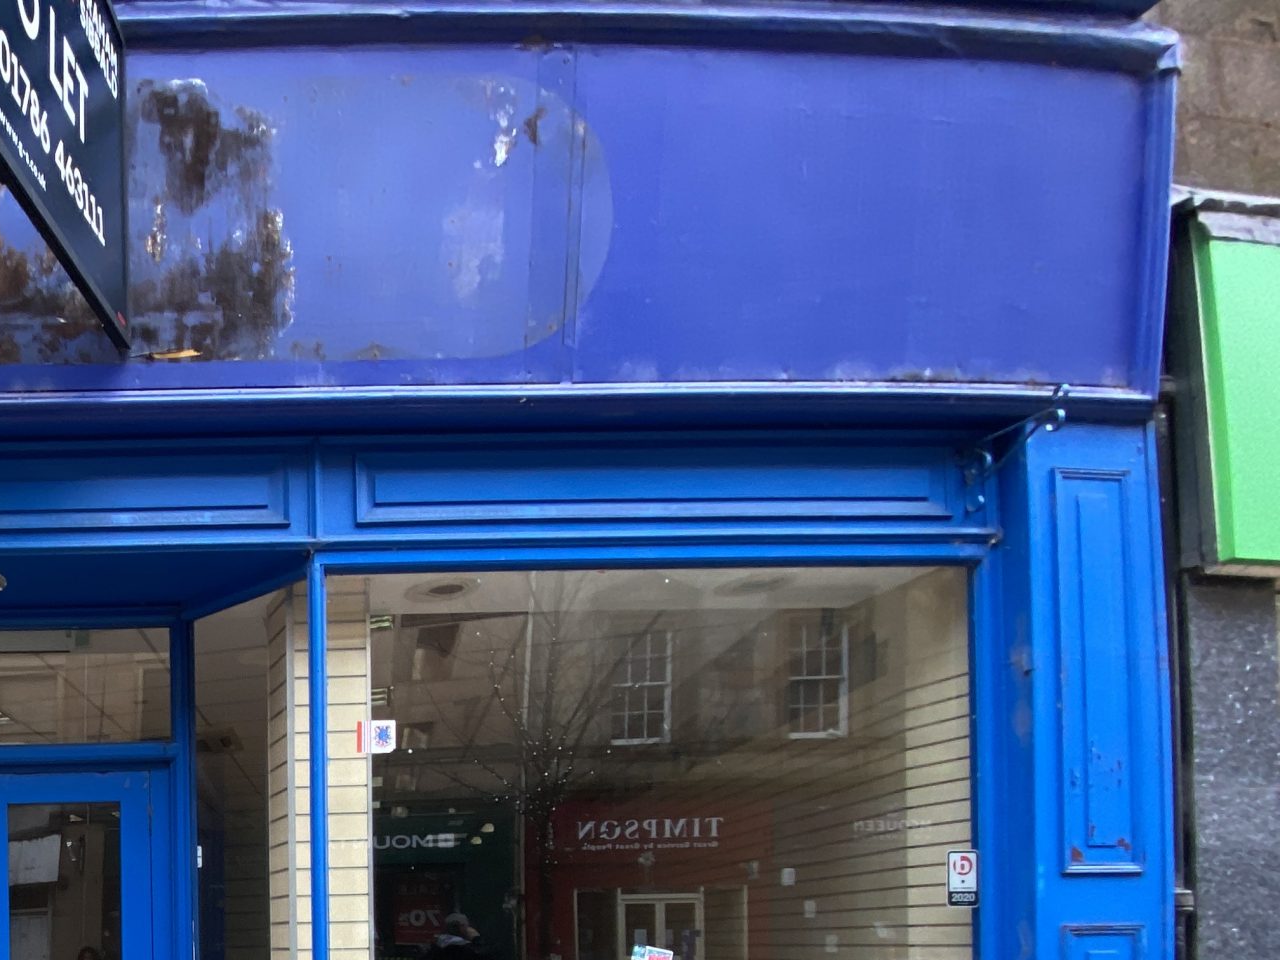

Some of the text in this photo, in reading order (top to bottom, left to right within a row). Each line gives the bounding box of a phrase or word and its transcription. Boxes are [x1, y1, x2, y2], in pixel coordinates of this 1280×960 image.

[49, 6, 89, 144] LET
[55, 140, 106, 247] 463111
[951, 893, 975, 902] 2020
